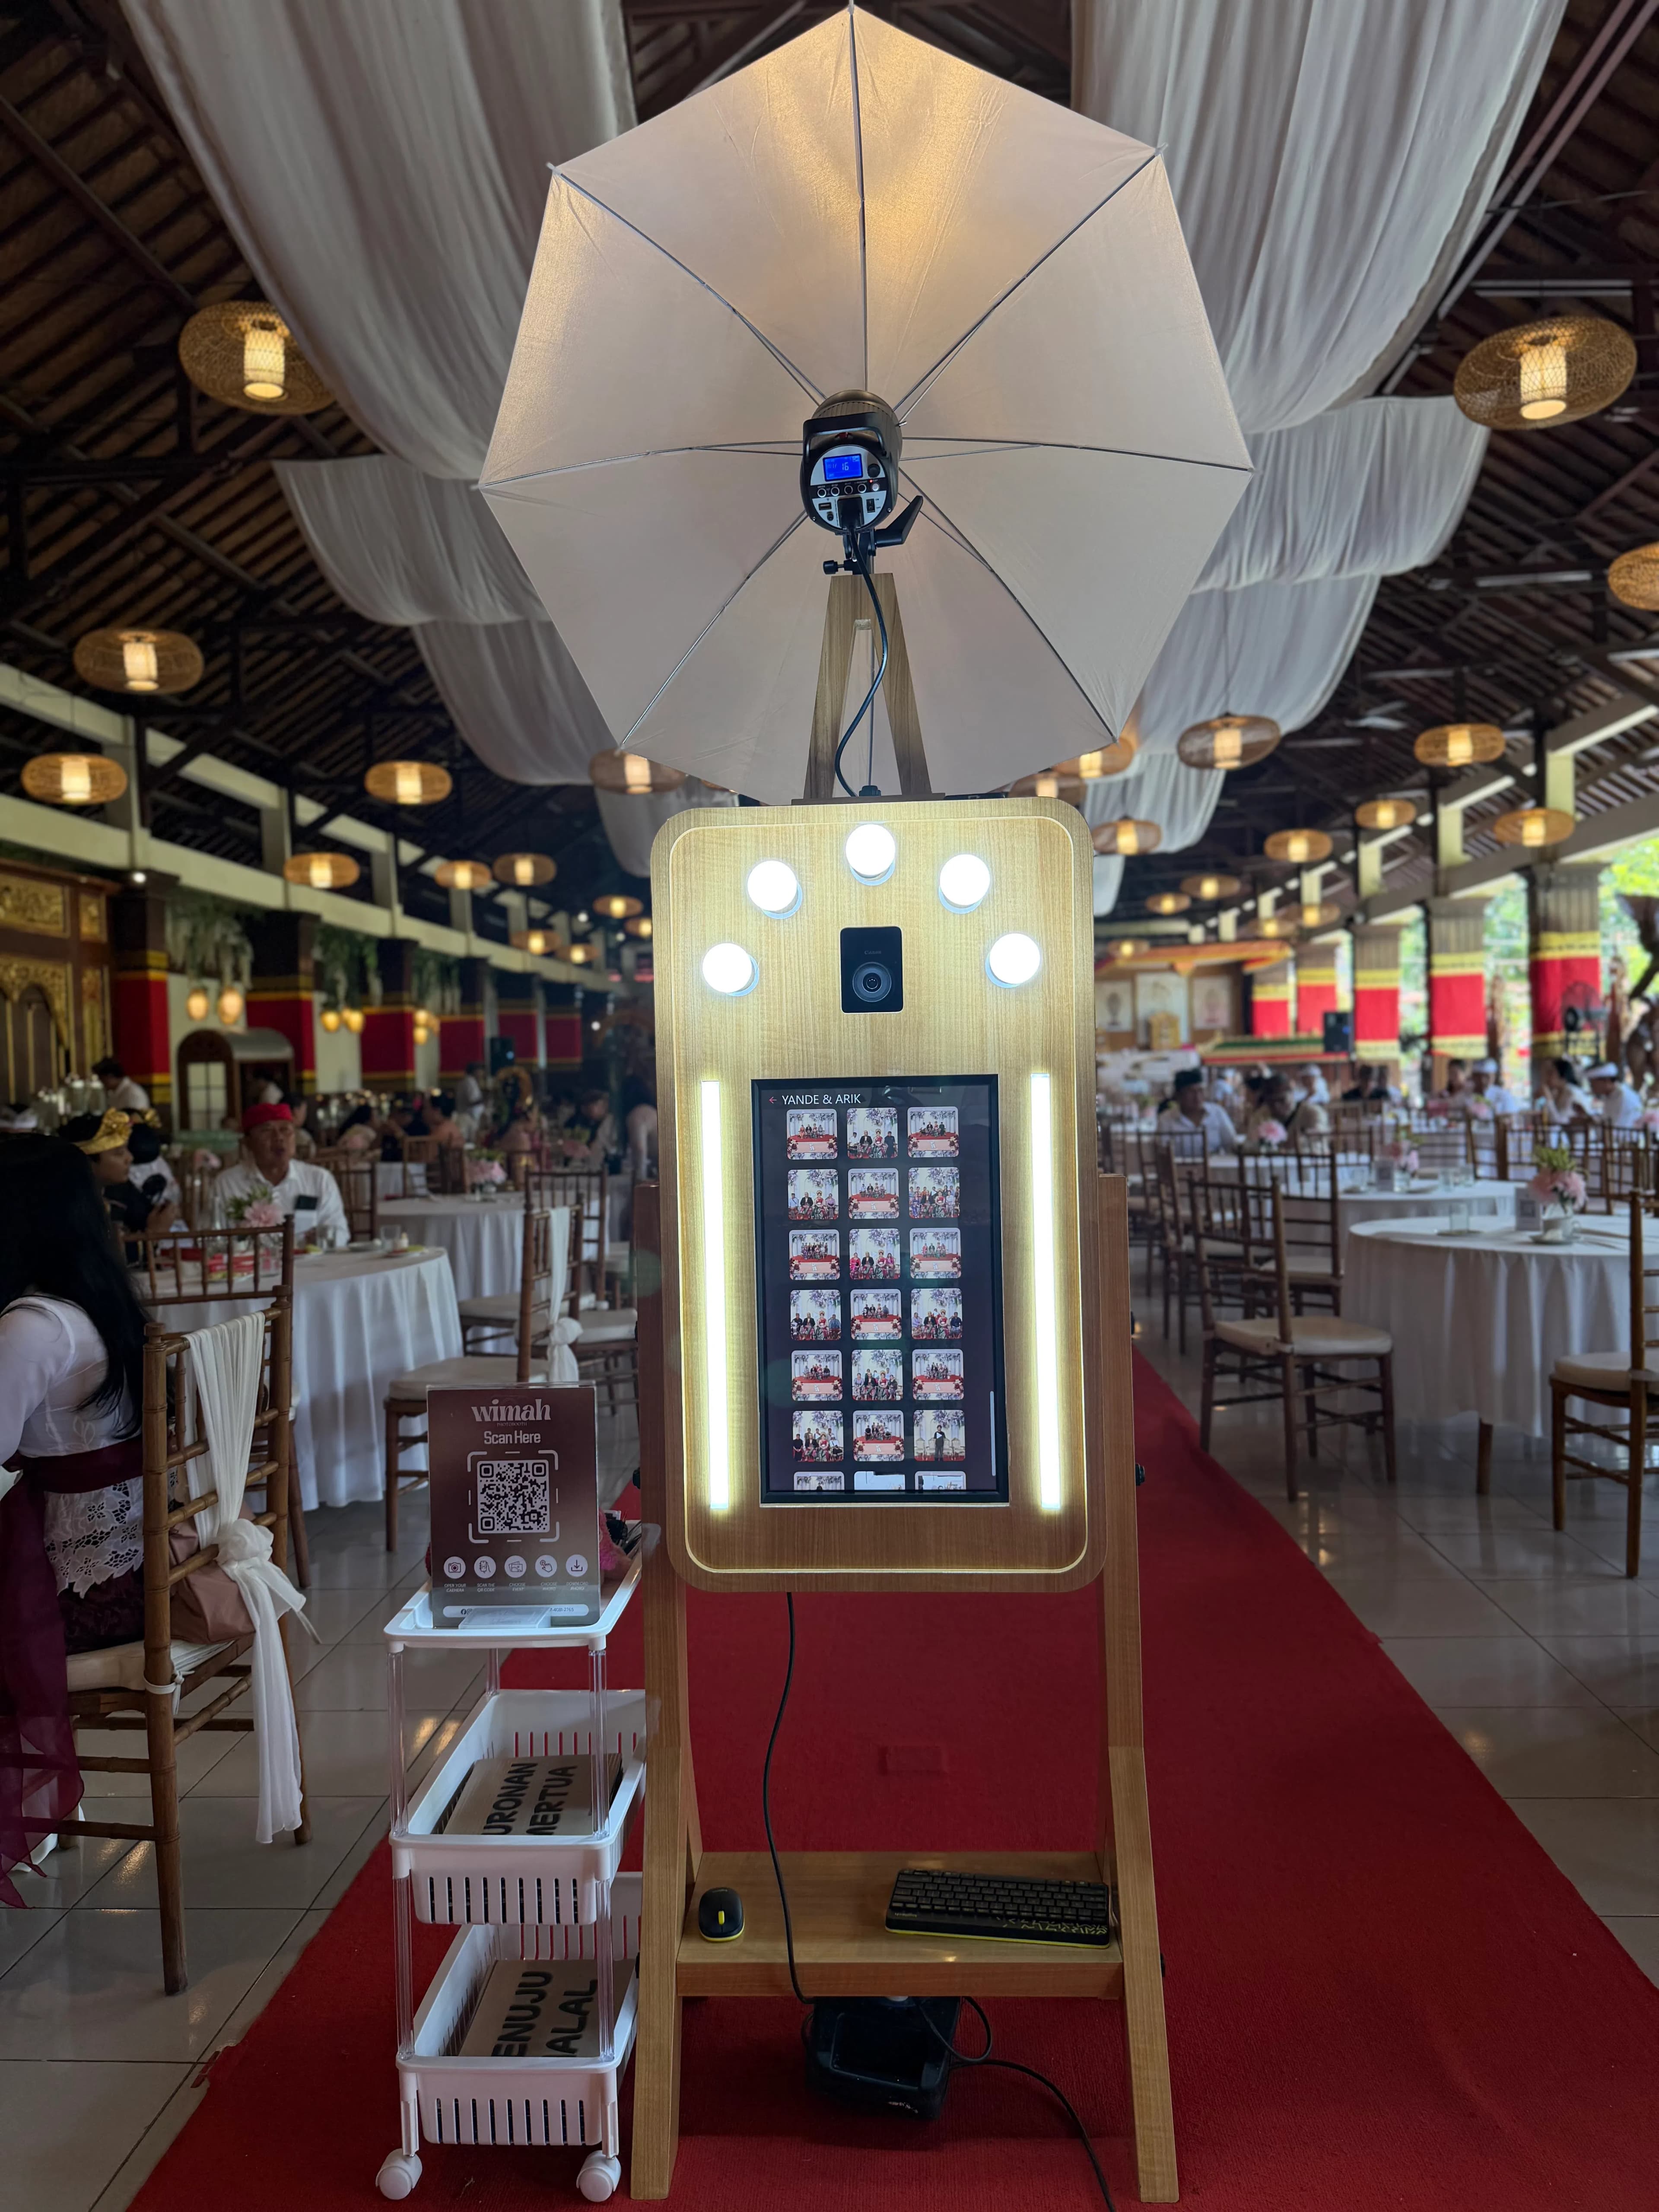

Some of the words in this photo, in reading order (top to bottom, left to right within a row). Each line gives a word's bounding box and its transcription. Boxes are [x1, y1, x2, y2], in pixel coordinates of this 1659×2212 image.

[842, 462, 849, 471] 16
[782, 1095, 820, 1105] YANDE
[823, 1094, 833, 1104] &
[835, 1093, 861, 1104] ARIK
[471, 1398, 551, 1422] wimah
[484, 1430, 513, 1445] Scan
[514, 1430, 541, 1444] Here
[542, 1980, 598, 2057] ALAL
